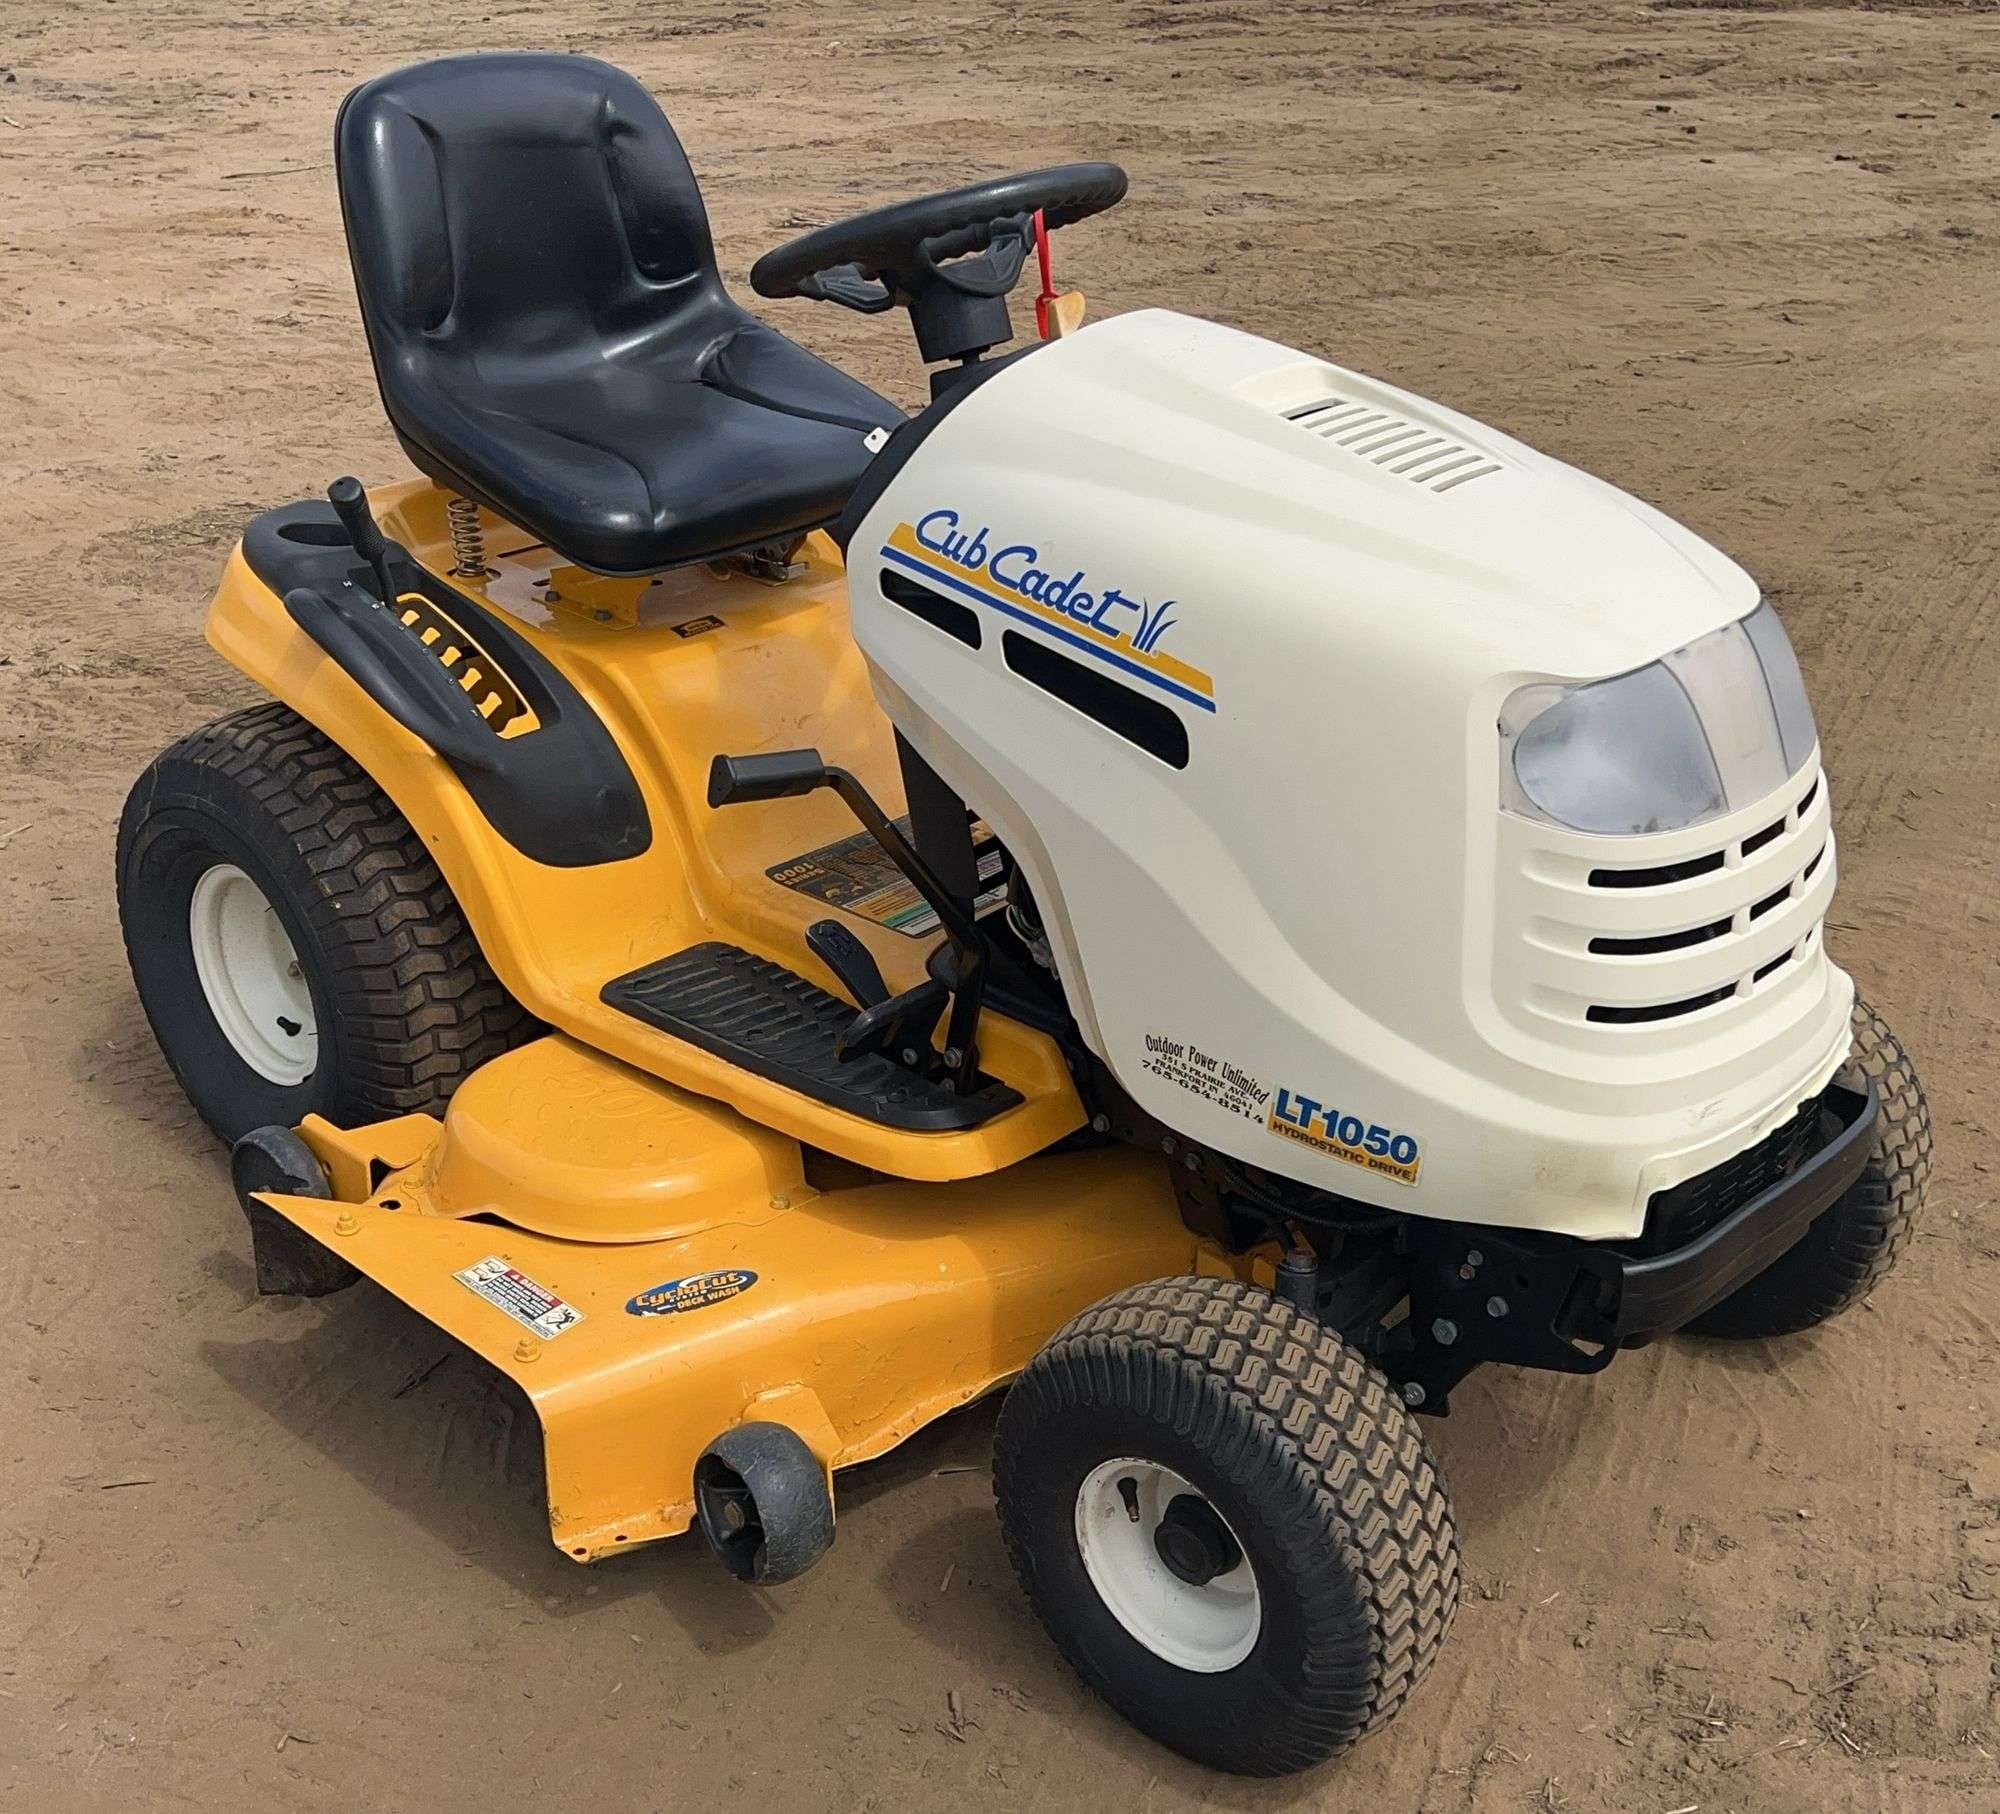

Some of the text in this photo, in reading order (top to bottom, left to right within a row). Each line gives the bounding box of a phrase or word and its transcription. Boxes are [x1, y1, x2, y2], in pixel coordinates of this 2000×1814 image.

[916, 510, 1141, 639] Cub Cadet
[774, 862, 814, 881] 1000
[1141, 1059, 1264, 1124] 765-654-8514
[1145, 1034, 1270, 1105] Outdoor Power Unlimited
[1155, 1058, 1206, 1088] FRANKFORT
[1181, 1062, 1187, 1070] S
[1189, 1066, 1226, 1089] PRAIRIE
[1272, 1121, 1412, 1180] HYDROSTATIC DRIVE
[1275, 1088, 1418, 1165] LT1050
[677, 1286, 739, 1309] DECK WASH
